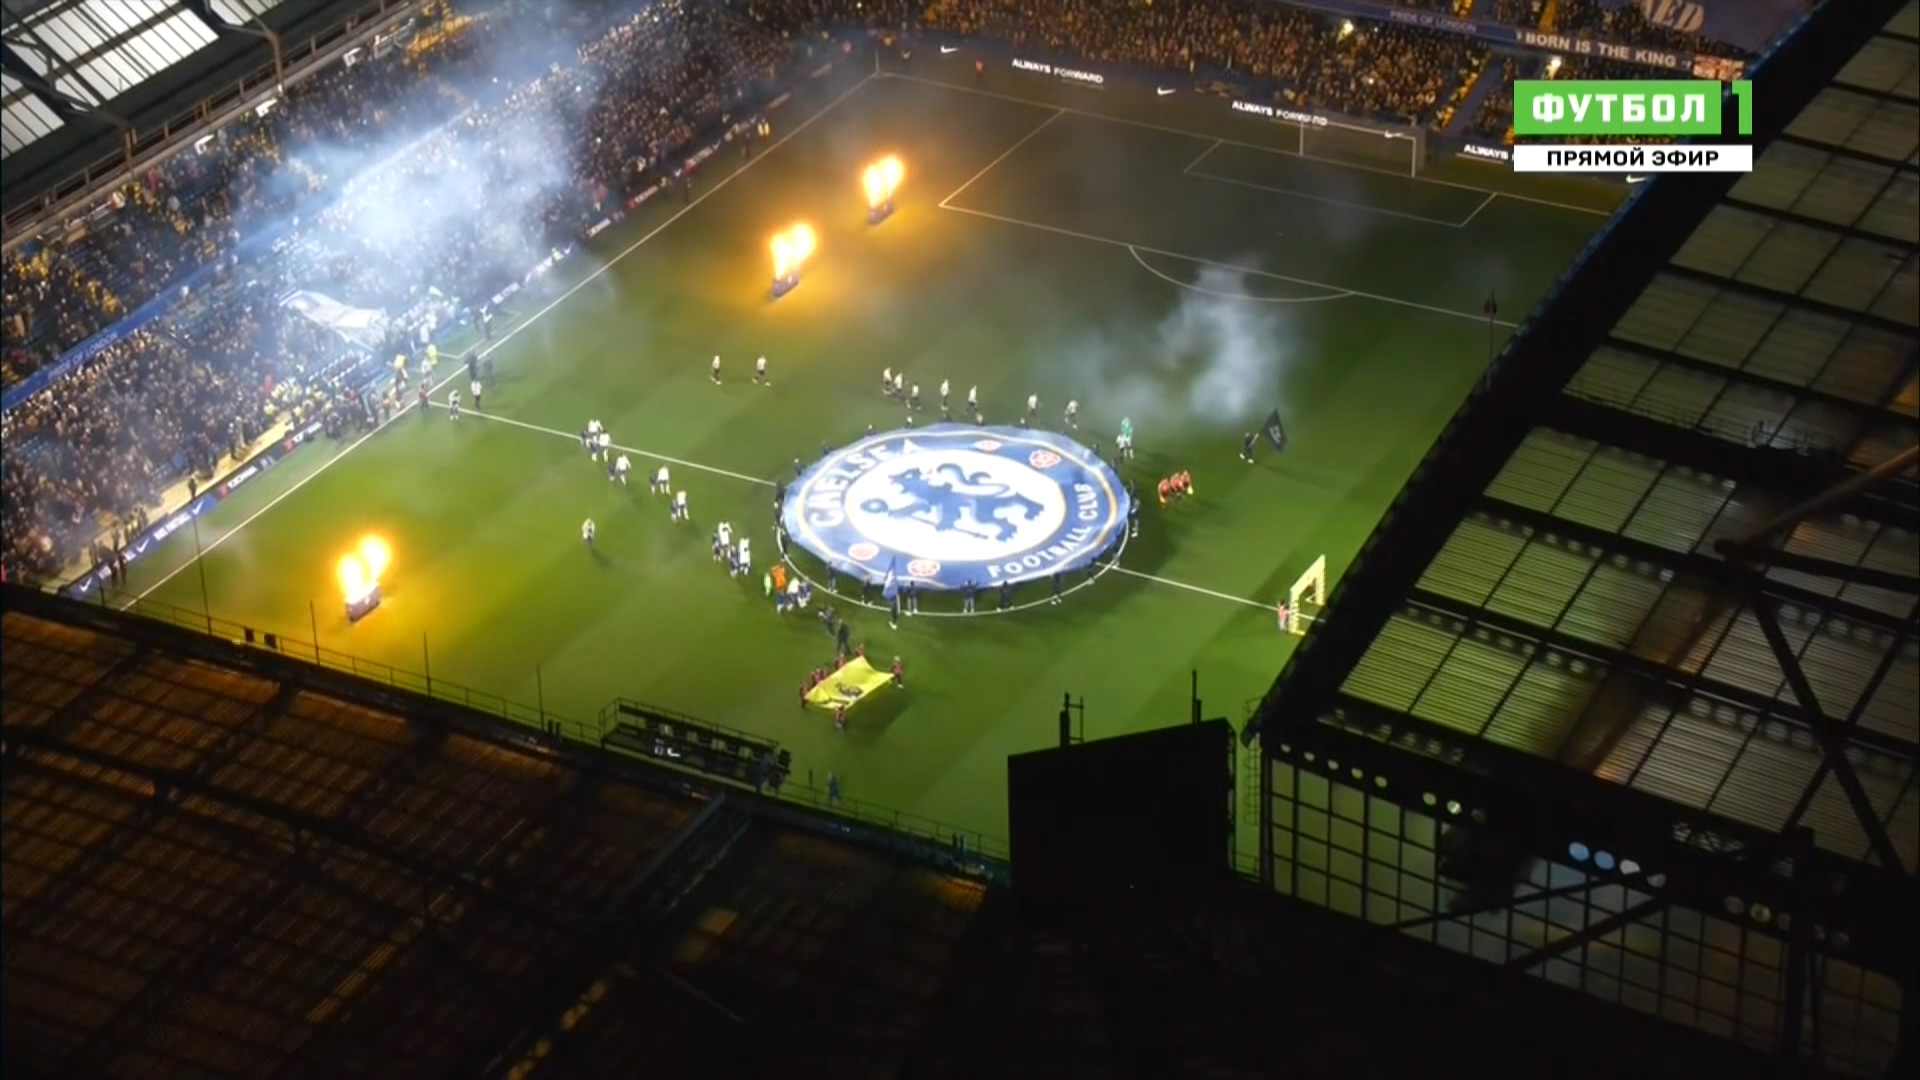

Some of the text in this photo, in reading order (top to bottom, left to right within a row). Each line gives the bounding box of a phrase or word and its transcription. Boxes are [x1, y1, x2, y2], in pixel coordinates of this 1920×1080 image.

[1436, 17, 1477, 33] LONDON
[1525, 32, 1677, 68] BORN IS THE KING
[1011, 58, 1104, 84] ALWAYS FORWARD
[1231, 100, 1273, 117] ALWAYS
[1463, 143, 1509, 161] ALWAYS
[807, 438, 922, 527] CHELSEA
[986, 483, 1094, 579] FOOTBALL CLUB
